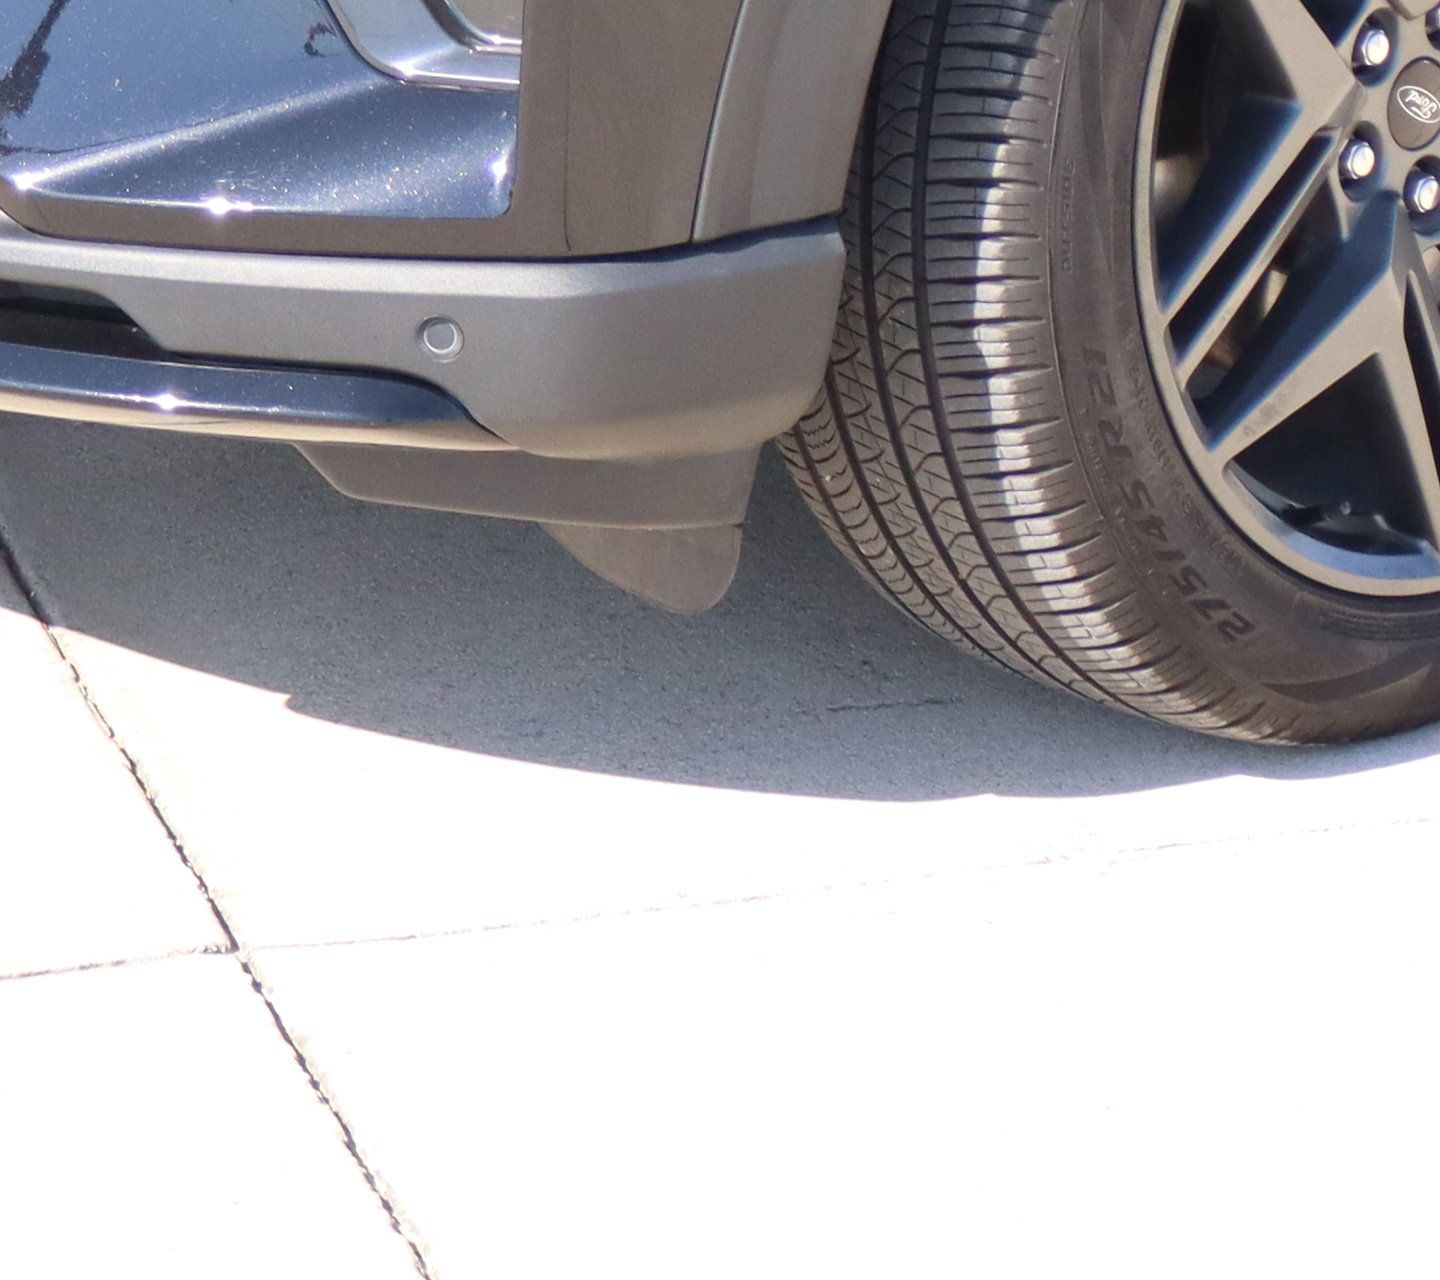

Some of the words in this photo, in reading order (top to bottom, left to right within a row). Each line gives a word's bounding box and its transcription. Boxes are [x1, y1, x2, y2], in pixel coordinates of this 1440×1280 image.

[1405, 90, 1437, 119] Ford
[1082, 345, 1117, 412] 21
[1097, 420, 1133, 461] R
[1122, 479, 1255, 645] 275/45
